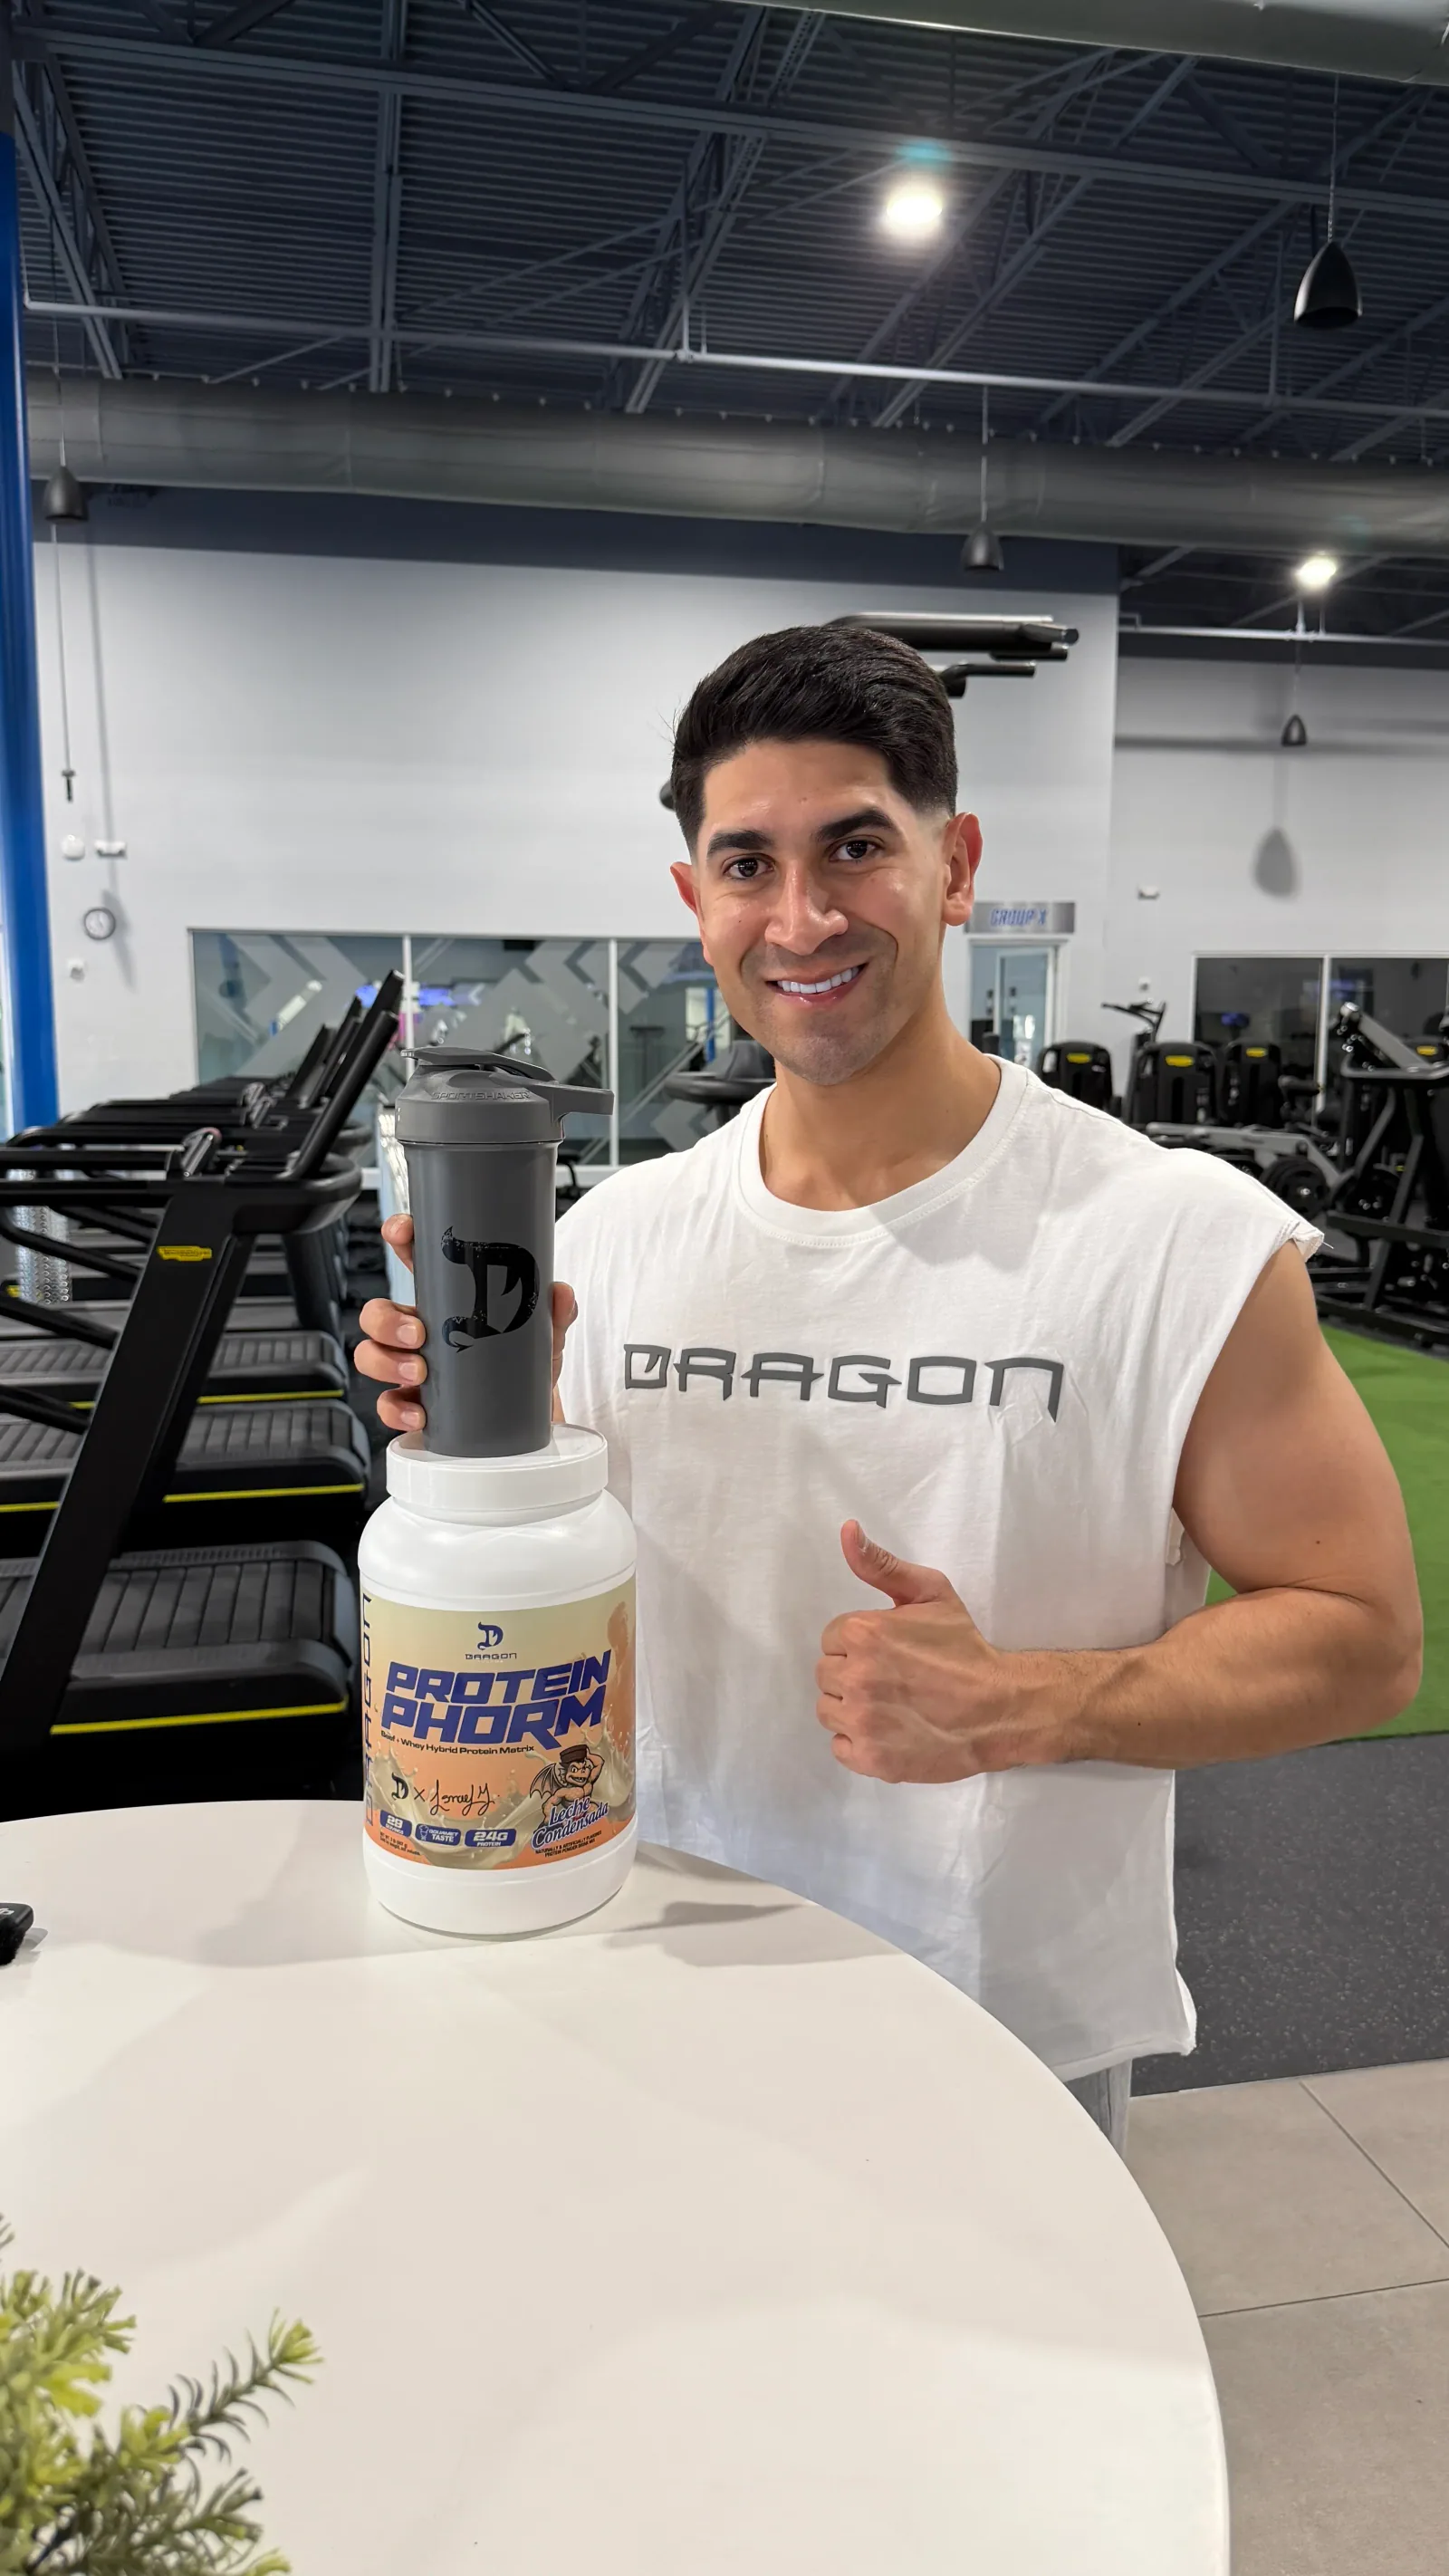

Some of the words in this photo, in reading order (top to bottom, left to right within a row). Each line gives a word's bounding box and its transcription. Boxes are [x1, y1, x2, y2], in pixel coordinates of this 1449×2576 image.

[623, 1343, 1064, 1423] DRAGON
[465, 1652, 517, 1660] DRAGON
[386, 1649, 611, 1704] PROTEIN
[381, 1685, 606, 1750] PHORM
[380, 1730, 396, 1742] Beef
[400, 1739, 424, 1751] Whey
[426, 1744, 458, 1754] Hybrid
[499, 1745, 534, 1754] Matrix
[532, 1802, 609, 1850] Condensada
[548, 1796, 590, 1826] Leche
[431, 1833, 455, 1842] TASTE
[473, 1831, 509, 1841] 24G
